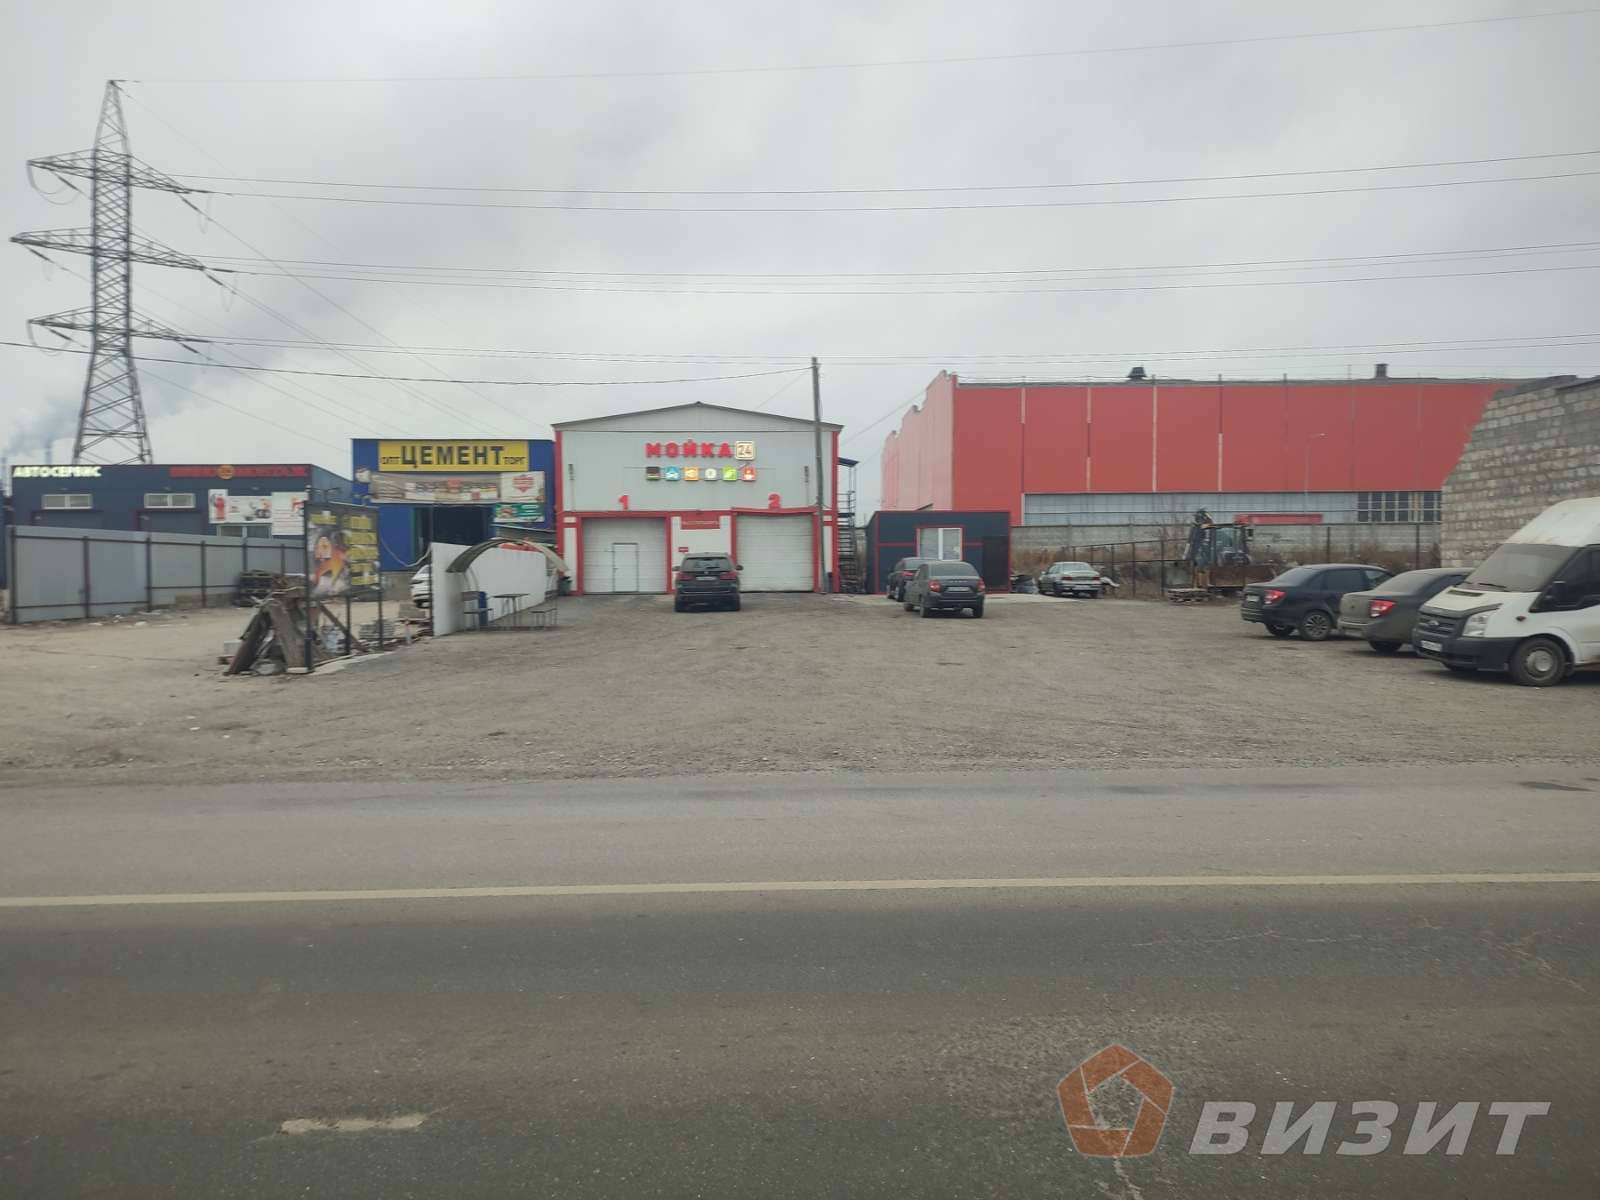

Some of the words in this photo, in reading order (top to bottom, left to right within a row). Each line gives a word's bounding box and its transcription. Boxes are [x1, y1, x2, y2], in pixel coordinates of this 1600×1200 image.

[645, 439, 732, 458] МОЙКА
[401, 446, 504, 469] ЦЕМЕНТ
[13, 466, 102, 478] АВТОСЕРВИС
[618, 495, 629, 510] 1
[768, 494, 781, 508] 2
